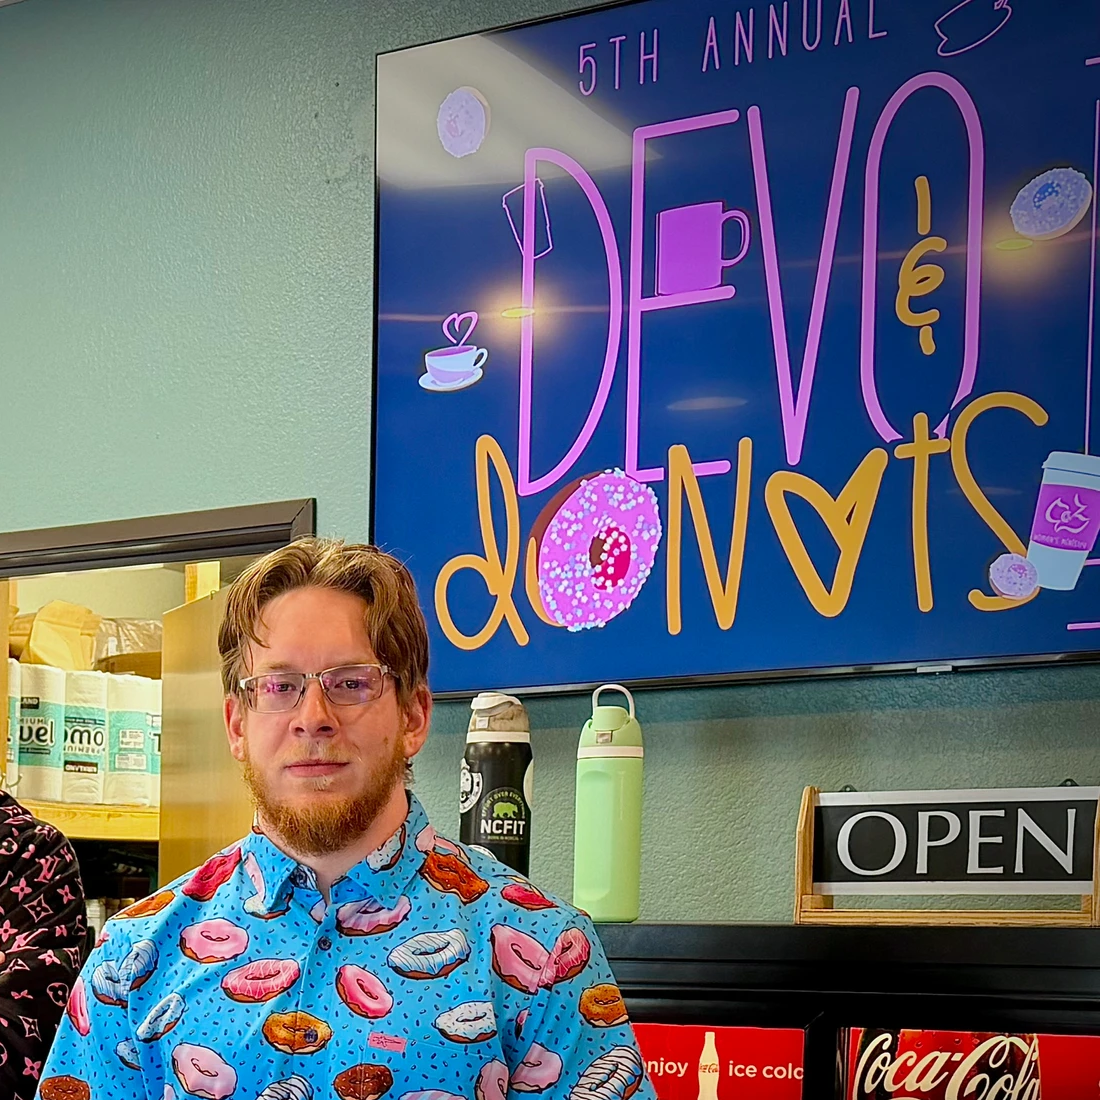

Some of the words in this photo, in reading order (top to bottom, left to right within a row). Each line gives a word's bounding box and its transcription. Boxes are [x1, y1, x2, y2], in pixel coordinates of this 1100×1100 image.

[578, 29, 658, 96] 5TH
[702, 0, 888, 72] ANNUAL
[518, 71, 985, 497] DEVO
[480, 819, 526, 835] NCFIT
[837, 808, 1077, 876] OPEN
[728, 1060, 758, 1077] ice
